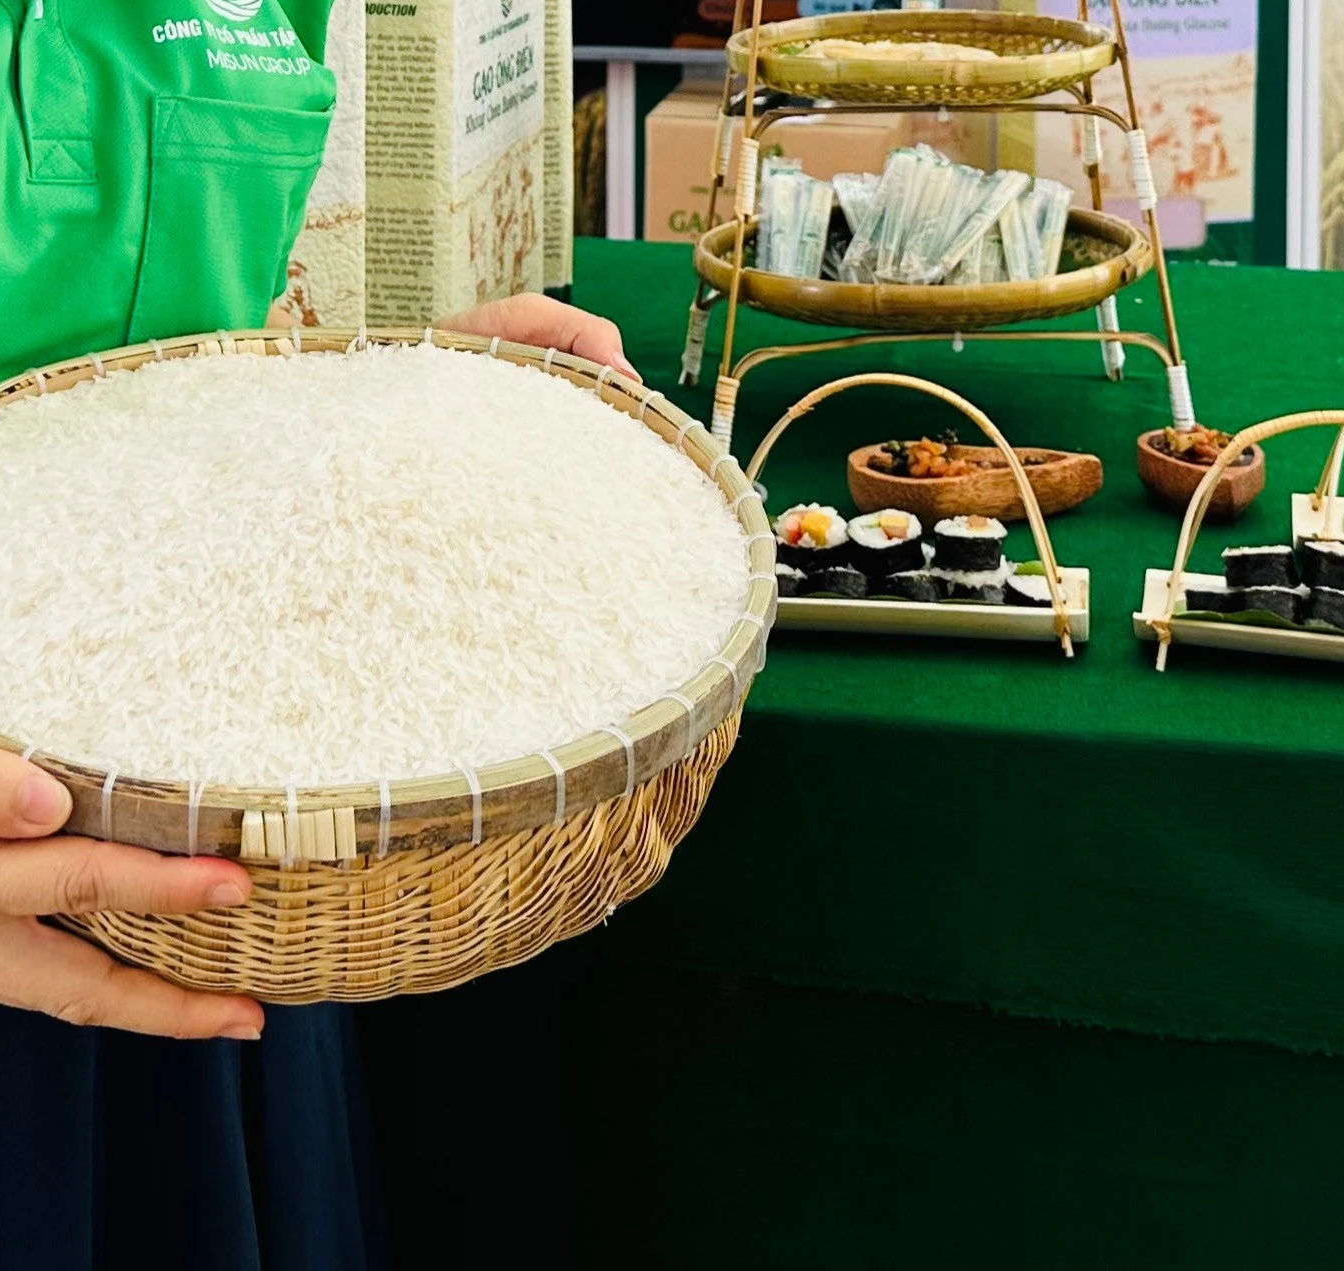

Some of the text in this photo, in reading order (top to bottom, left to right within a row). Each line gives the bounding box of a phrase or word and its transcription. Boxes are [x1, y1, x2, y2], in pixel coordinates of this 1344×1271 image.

[152, 19, 202, 43] CÔNG
[270, 27, 296, 50] TẬP
[207, 49, 310, 75] MISUN GROUP
